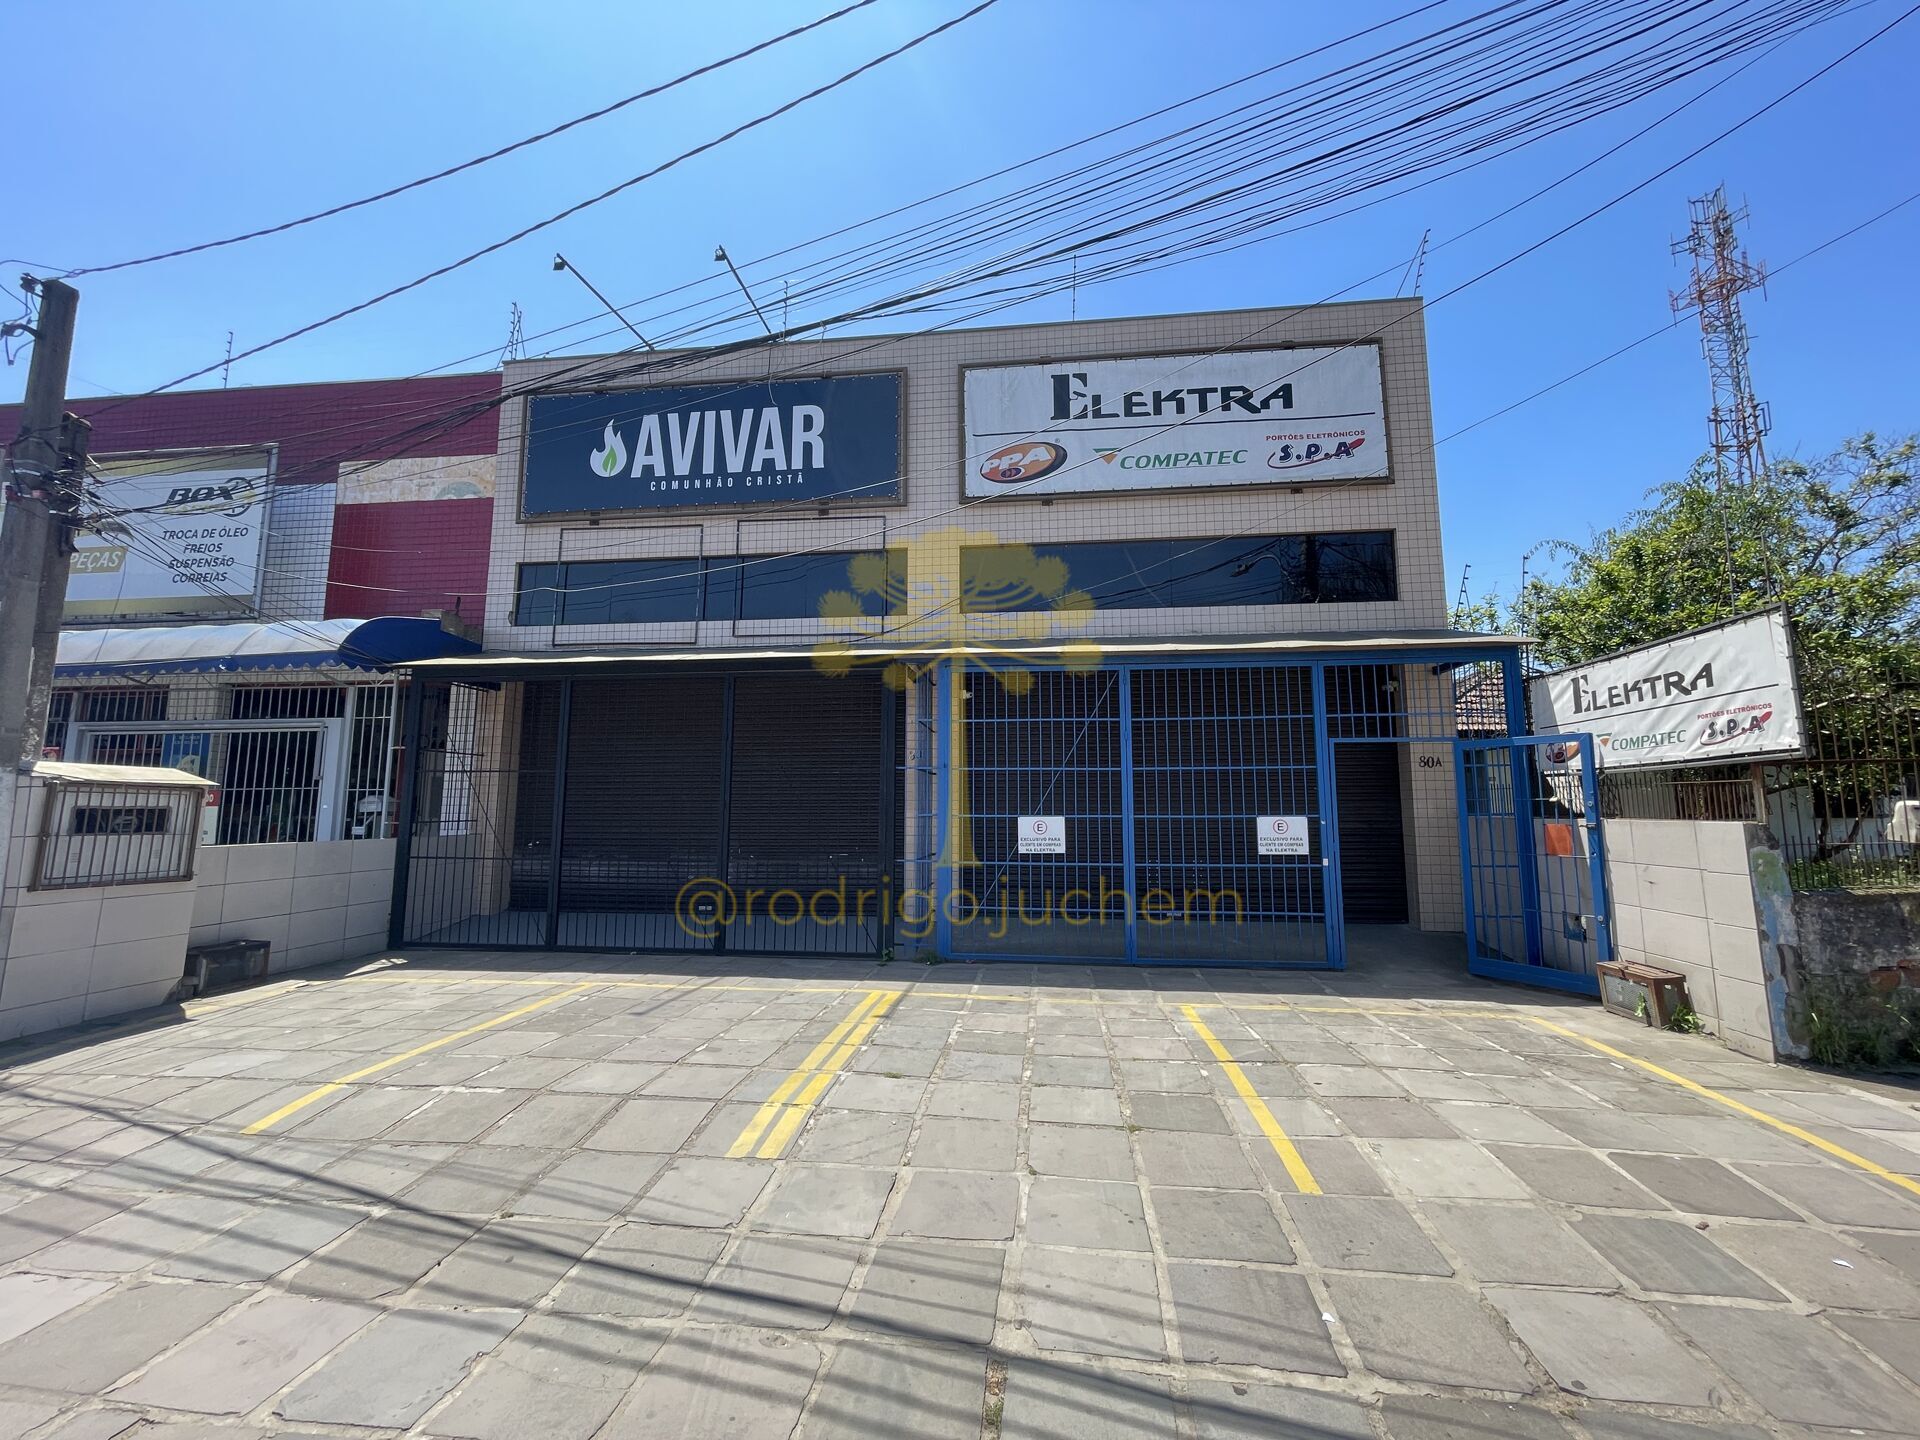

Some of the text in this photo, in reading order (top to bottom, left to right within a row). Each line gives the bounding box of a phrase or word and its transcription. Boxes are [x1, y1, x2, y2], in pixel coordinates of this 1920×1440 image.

[1050, 372, 1294, 421] ELEKTRA
[630, 404, 825, 478] AVIVAR
[1265, 429, 1366, 441] PORTÕES ELETRÔNICOS
[981, 446, 1053, 474] PPA
[1119, 449, 1249, 470] COMPATEC
[650, 472, 804, 491] COMUNHÃO CRISTÃ
[166, 486, 235, 504] BOX
[162, 525, 249, 540] TROCA DE ÓLEO
[183, 542, 223, 554] FREIOS
[69, 550, 122, 571] PEÇAS
[167, 554, 235, 569] SUSPENSÃO
[172, 572, 228, 584] CORREIAS
[1570, 662, 1715, 715] ELEKTRA
[1697, 702, 1772, 719] PORTÕES ELETRÔNICOS
[1611, 729, 1687, 751] COMPATEC
[1418, 755, 1443, 768] 80A
[1037, 823, 1043, 832] E
[1277, 822, 1284, 831] E
